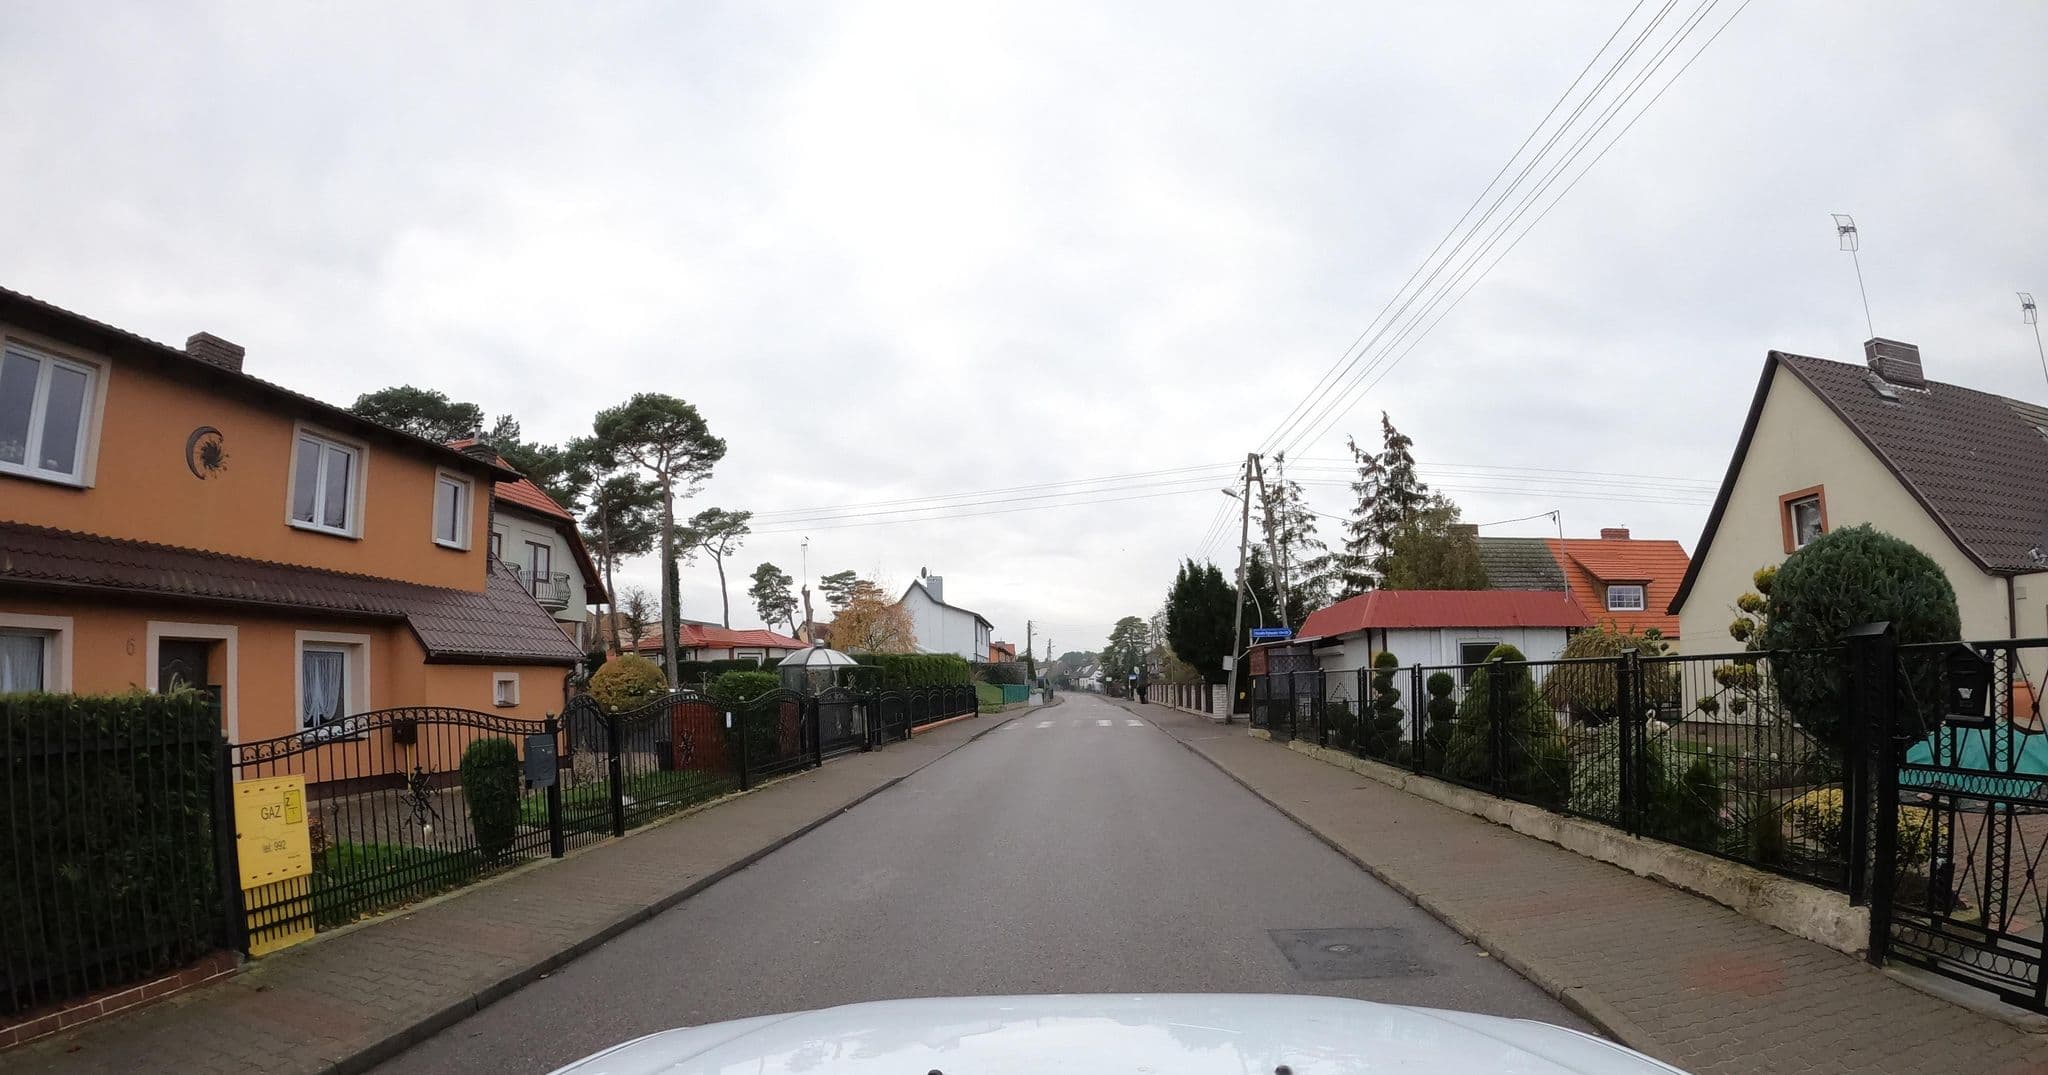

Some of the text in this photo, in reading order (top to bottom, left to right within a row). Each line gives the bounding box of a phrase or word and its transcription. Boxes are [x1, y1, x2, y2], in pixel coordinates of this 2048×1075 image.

[126, 638, 135, 656] 6
[261, 805, 281, 820] GAZ
[274, 840, 286, 851] 992
